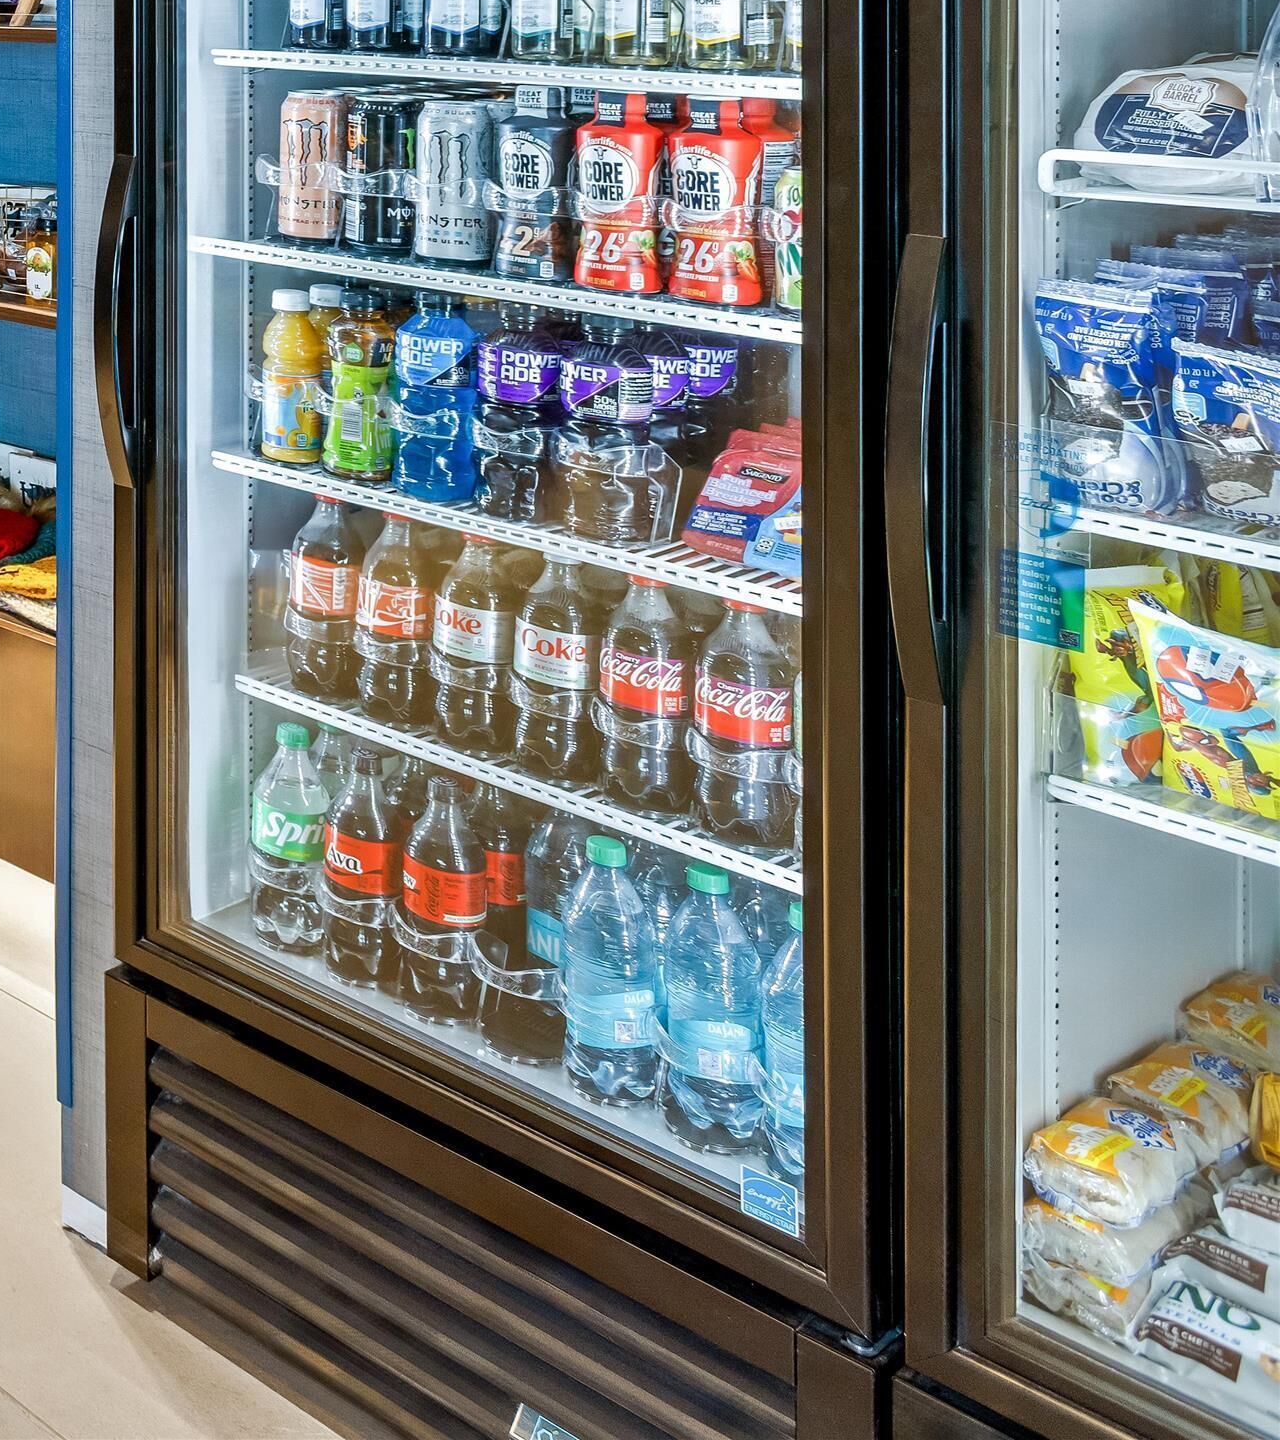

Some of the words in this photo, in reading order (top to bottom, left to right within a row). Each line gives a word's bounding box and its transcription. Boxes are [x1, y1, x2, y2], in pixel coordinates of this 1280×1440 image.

[517, 90, 543, 98] GREAT
[1167, 83, 1193, 94] BLOCK
[517, 97, 543, 105] TASTE
[1162, 90, 1199, 104] BARREL
[598, 102, 622, 112] GREAT
[598, 109, 622, 118] TASTE
[690, 111, 717, 120] GREAT
[503, 152, 540, 174] CORE
[584, 160, 624, 185] CORE
[504, 174, 540, 191] POWER
[676, 169, 721, 194] CORE
[585, 185, 624, 203] POWER
[678, 193, 721, 212] POWER
[500, 366, 541, 384] ADE
[593, 395, 618, 406] 50%
[593, 404, 619, 412] MORE
[740, 468, 784, 483] SARGENTO
[709, 479, 778, 501] Balanced
[1037, 613, 1052, 626] the
[521, 627, 587, 663] Coke
[615, 651, 641, 665] Cherry
[599, 647, 682, 693] Coca-Cola
[716, 681, 743, 694] Cherry
[694, 676, 787, 723] Coca-Cola
[327, 844, 363, 874] Ava
[744, 1203, 774, 1223] ENERGY
[774, 1217, 796, 1234] STAR
